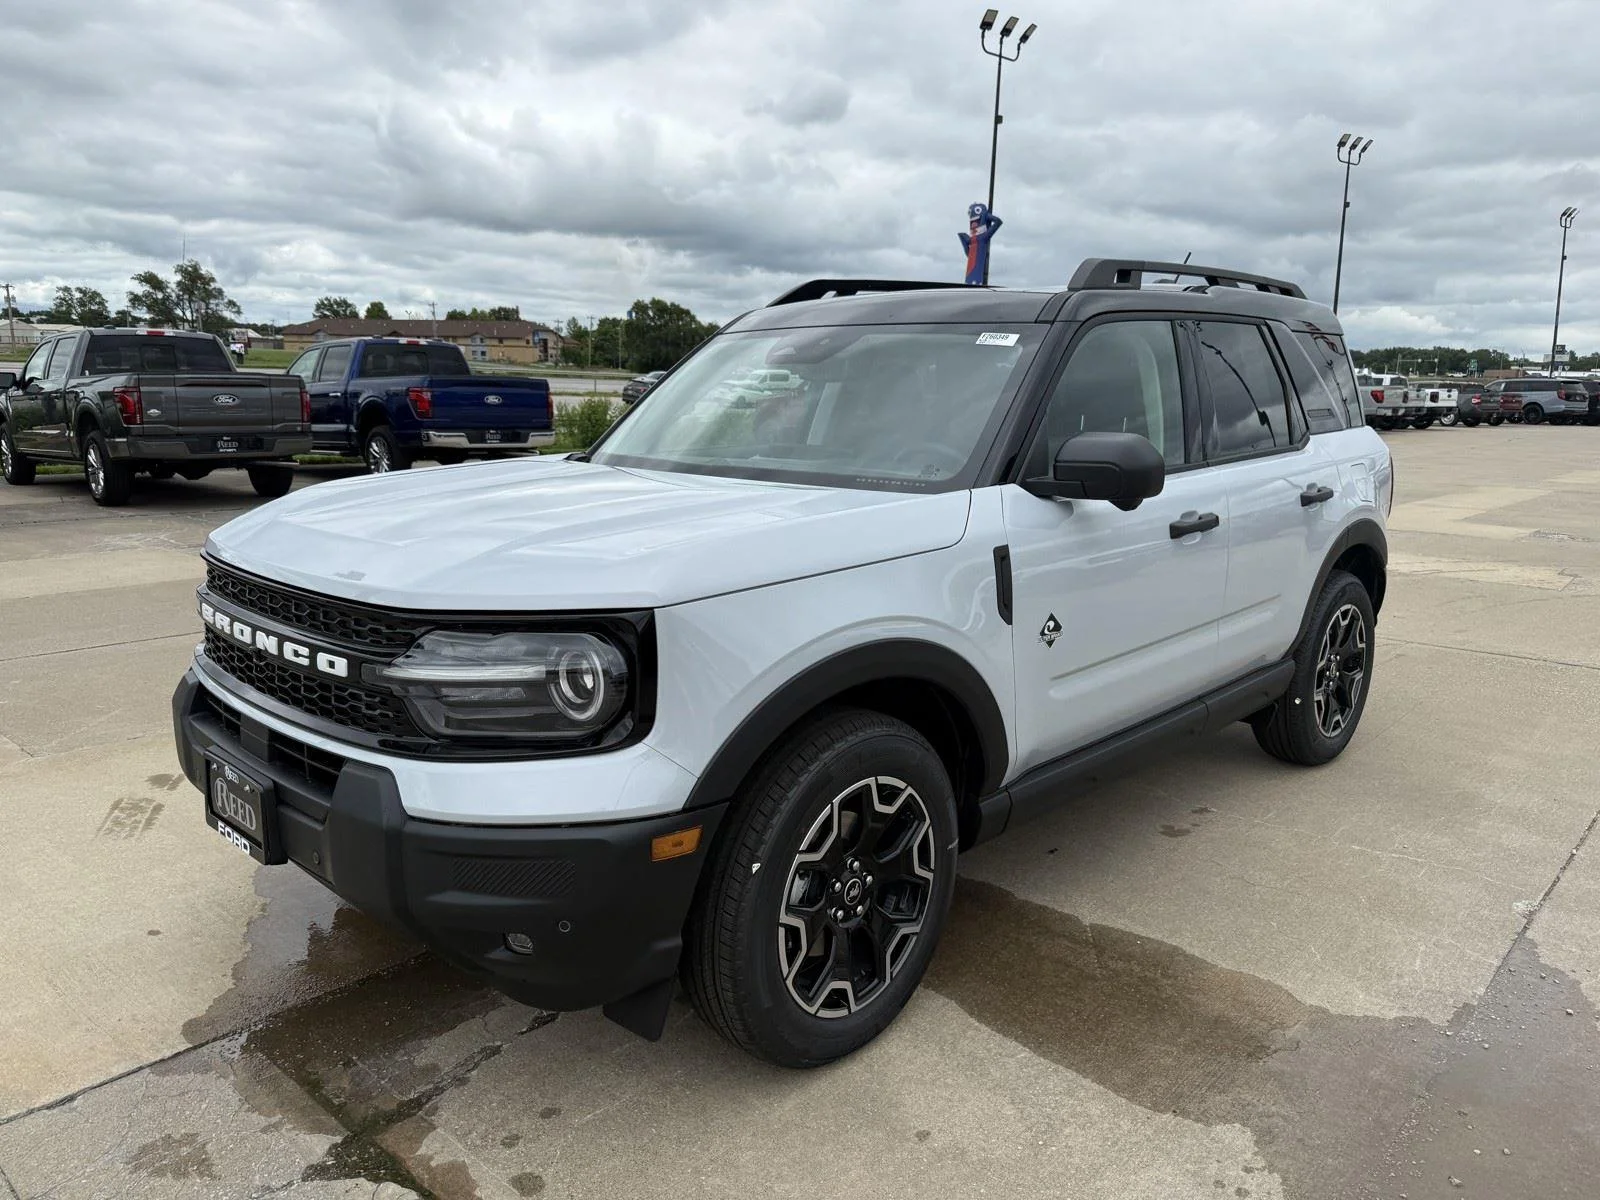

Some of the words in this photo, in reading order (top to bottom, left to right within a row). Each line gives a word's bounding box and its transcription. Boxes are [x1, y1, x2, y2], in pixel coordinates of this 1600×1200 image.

[201, 602, 349, 678] BRONCO
[214, 777, 257, 831] REED
[217, 820, 250, 855] FORD
